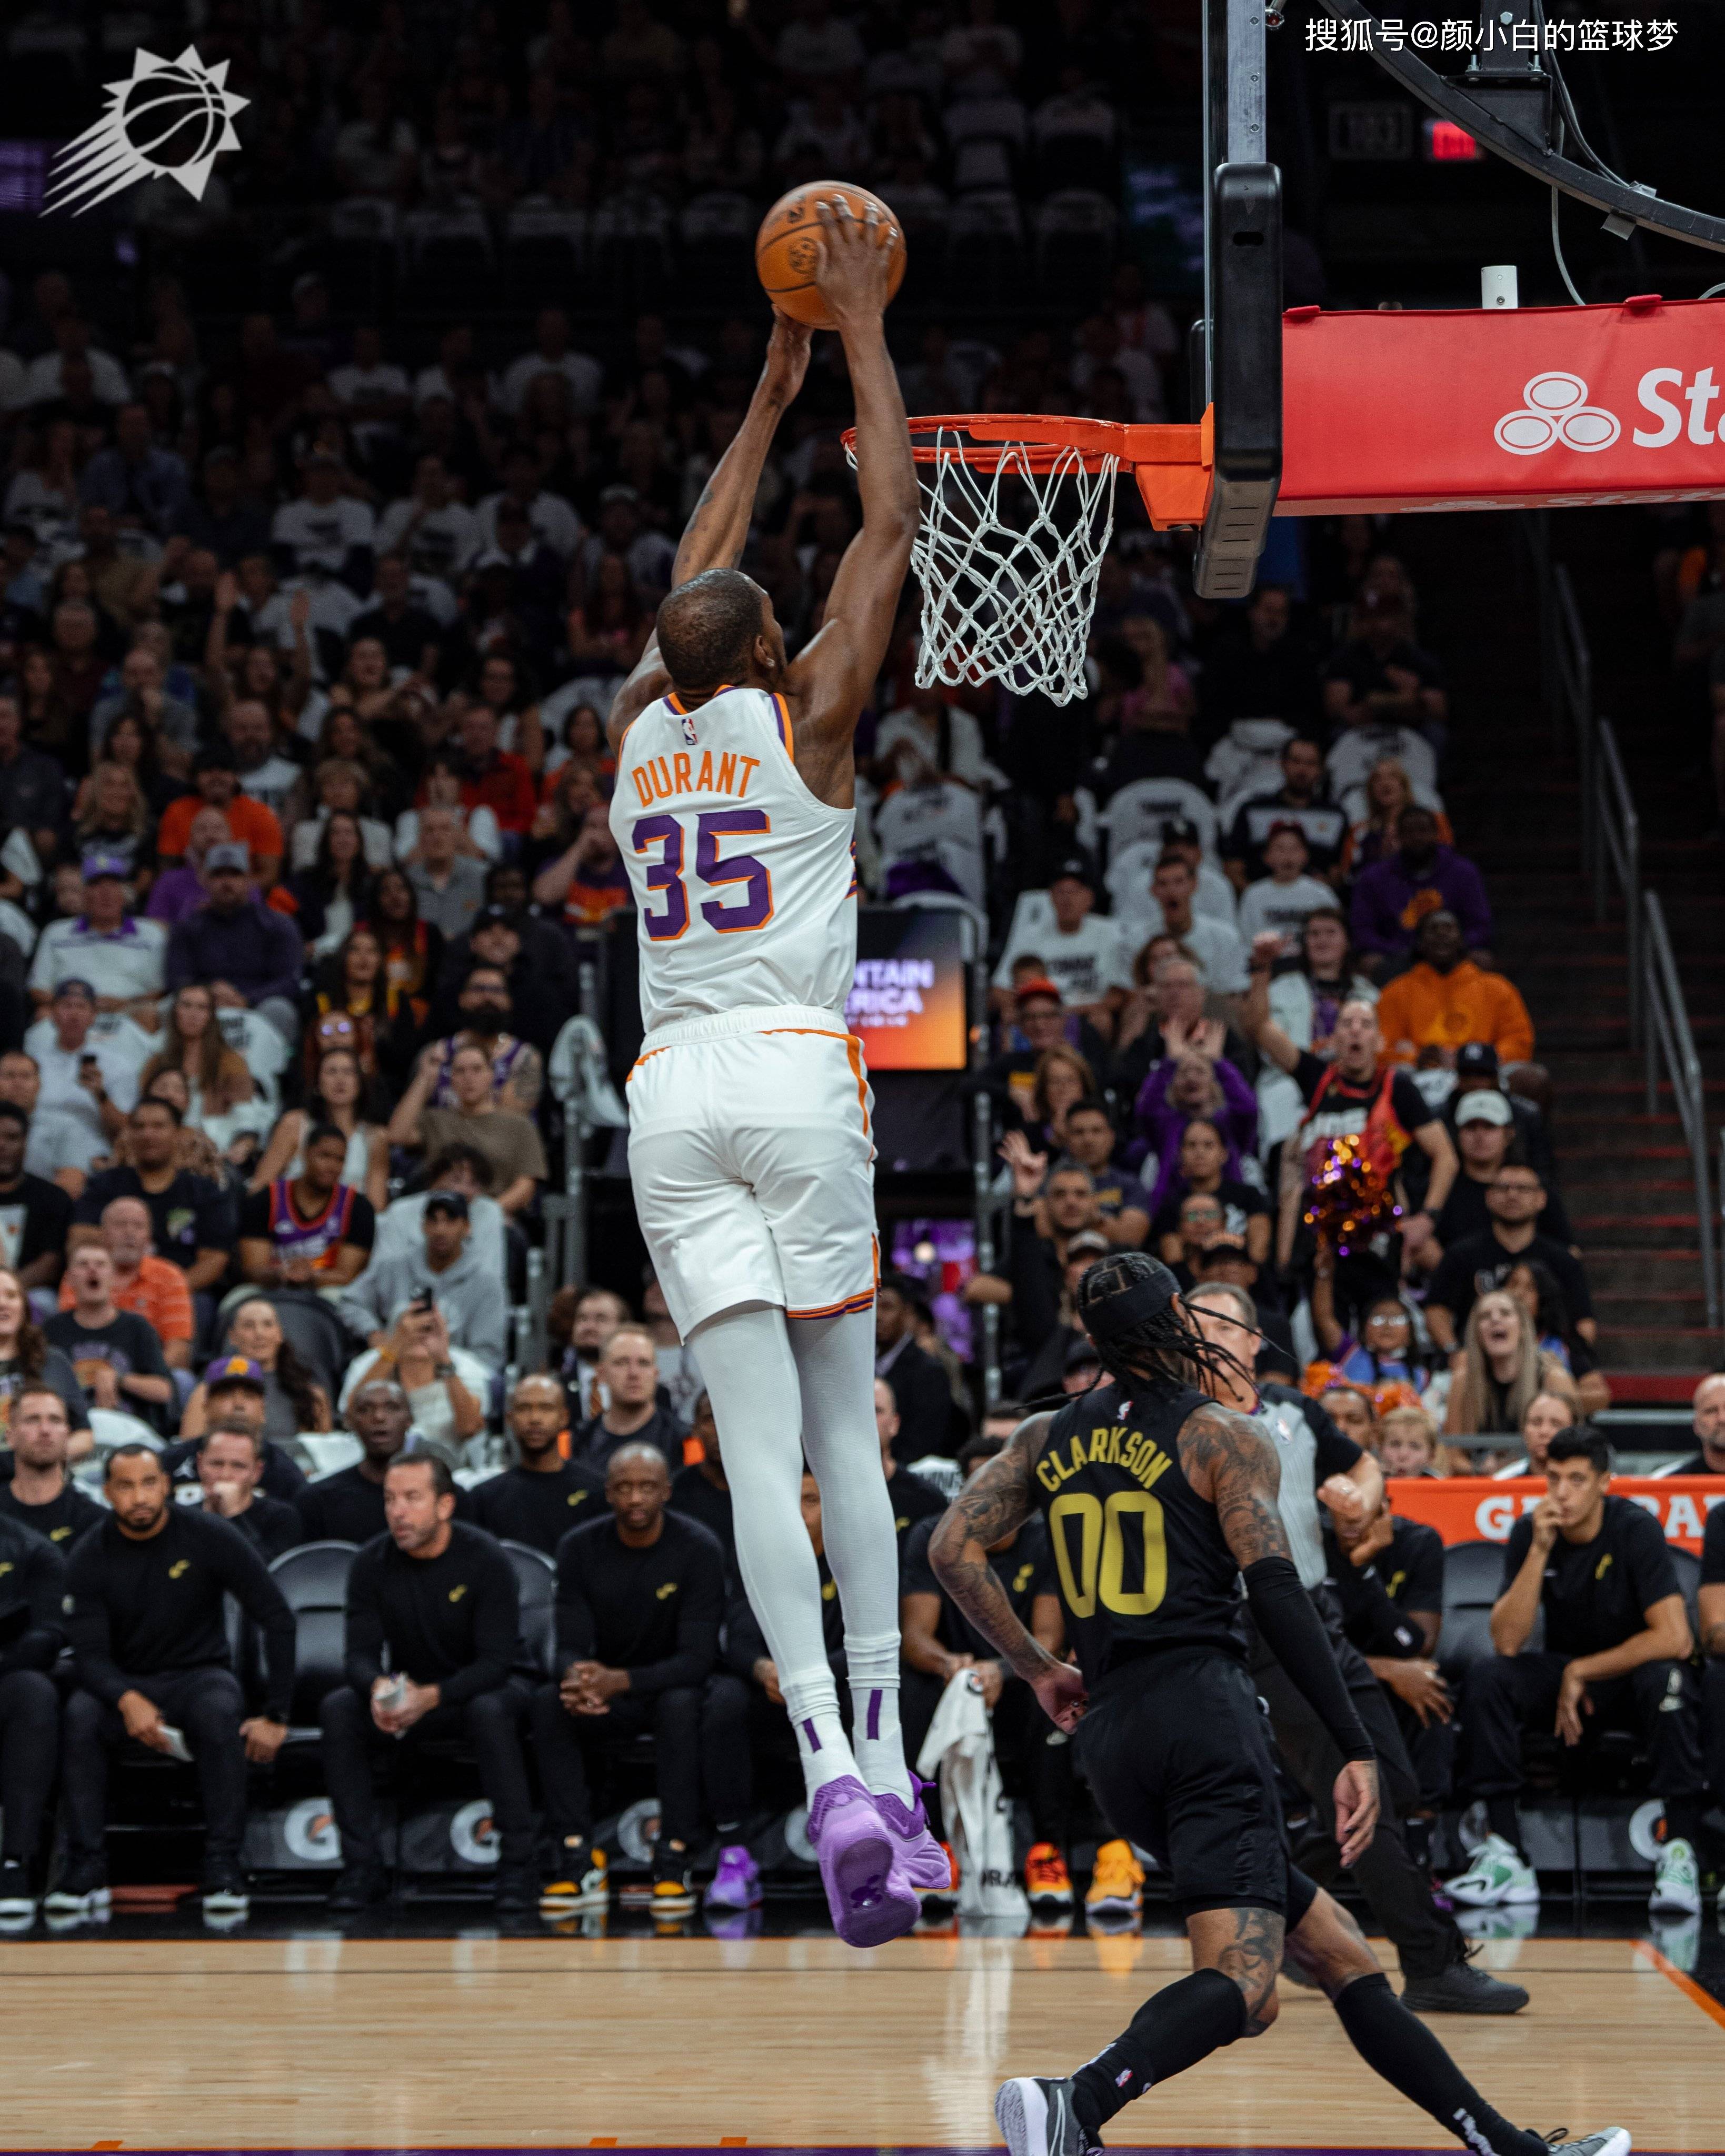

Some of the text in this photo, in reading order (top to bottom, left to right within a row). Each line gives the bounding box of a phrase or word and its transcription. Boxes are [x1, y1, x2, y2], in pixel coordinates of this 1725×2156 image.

[1632, 366, 1725, 448] St
[632, 751, 761, 807] DURANT
[632, 809, 774, 941] 35
[844, 988, 924, 1015] ERICA
[1036, 1426, 1173, 1492] CLARKSON
[1049, 1491, 1168, 1618] 00
